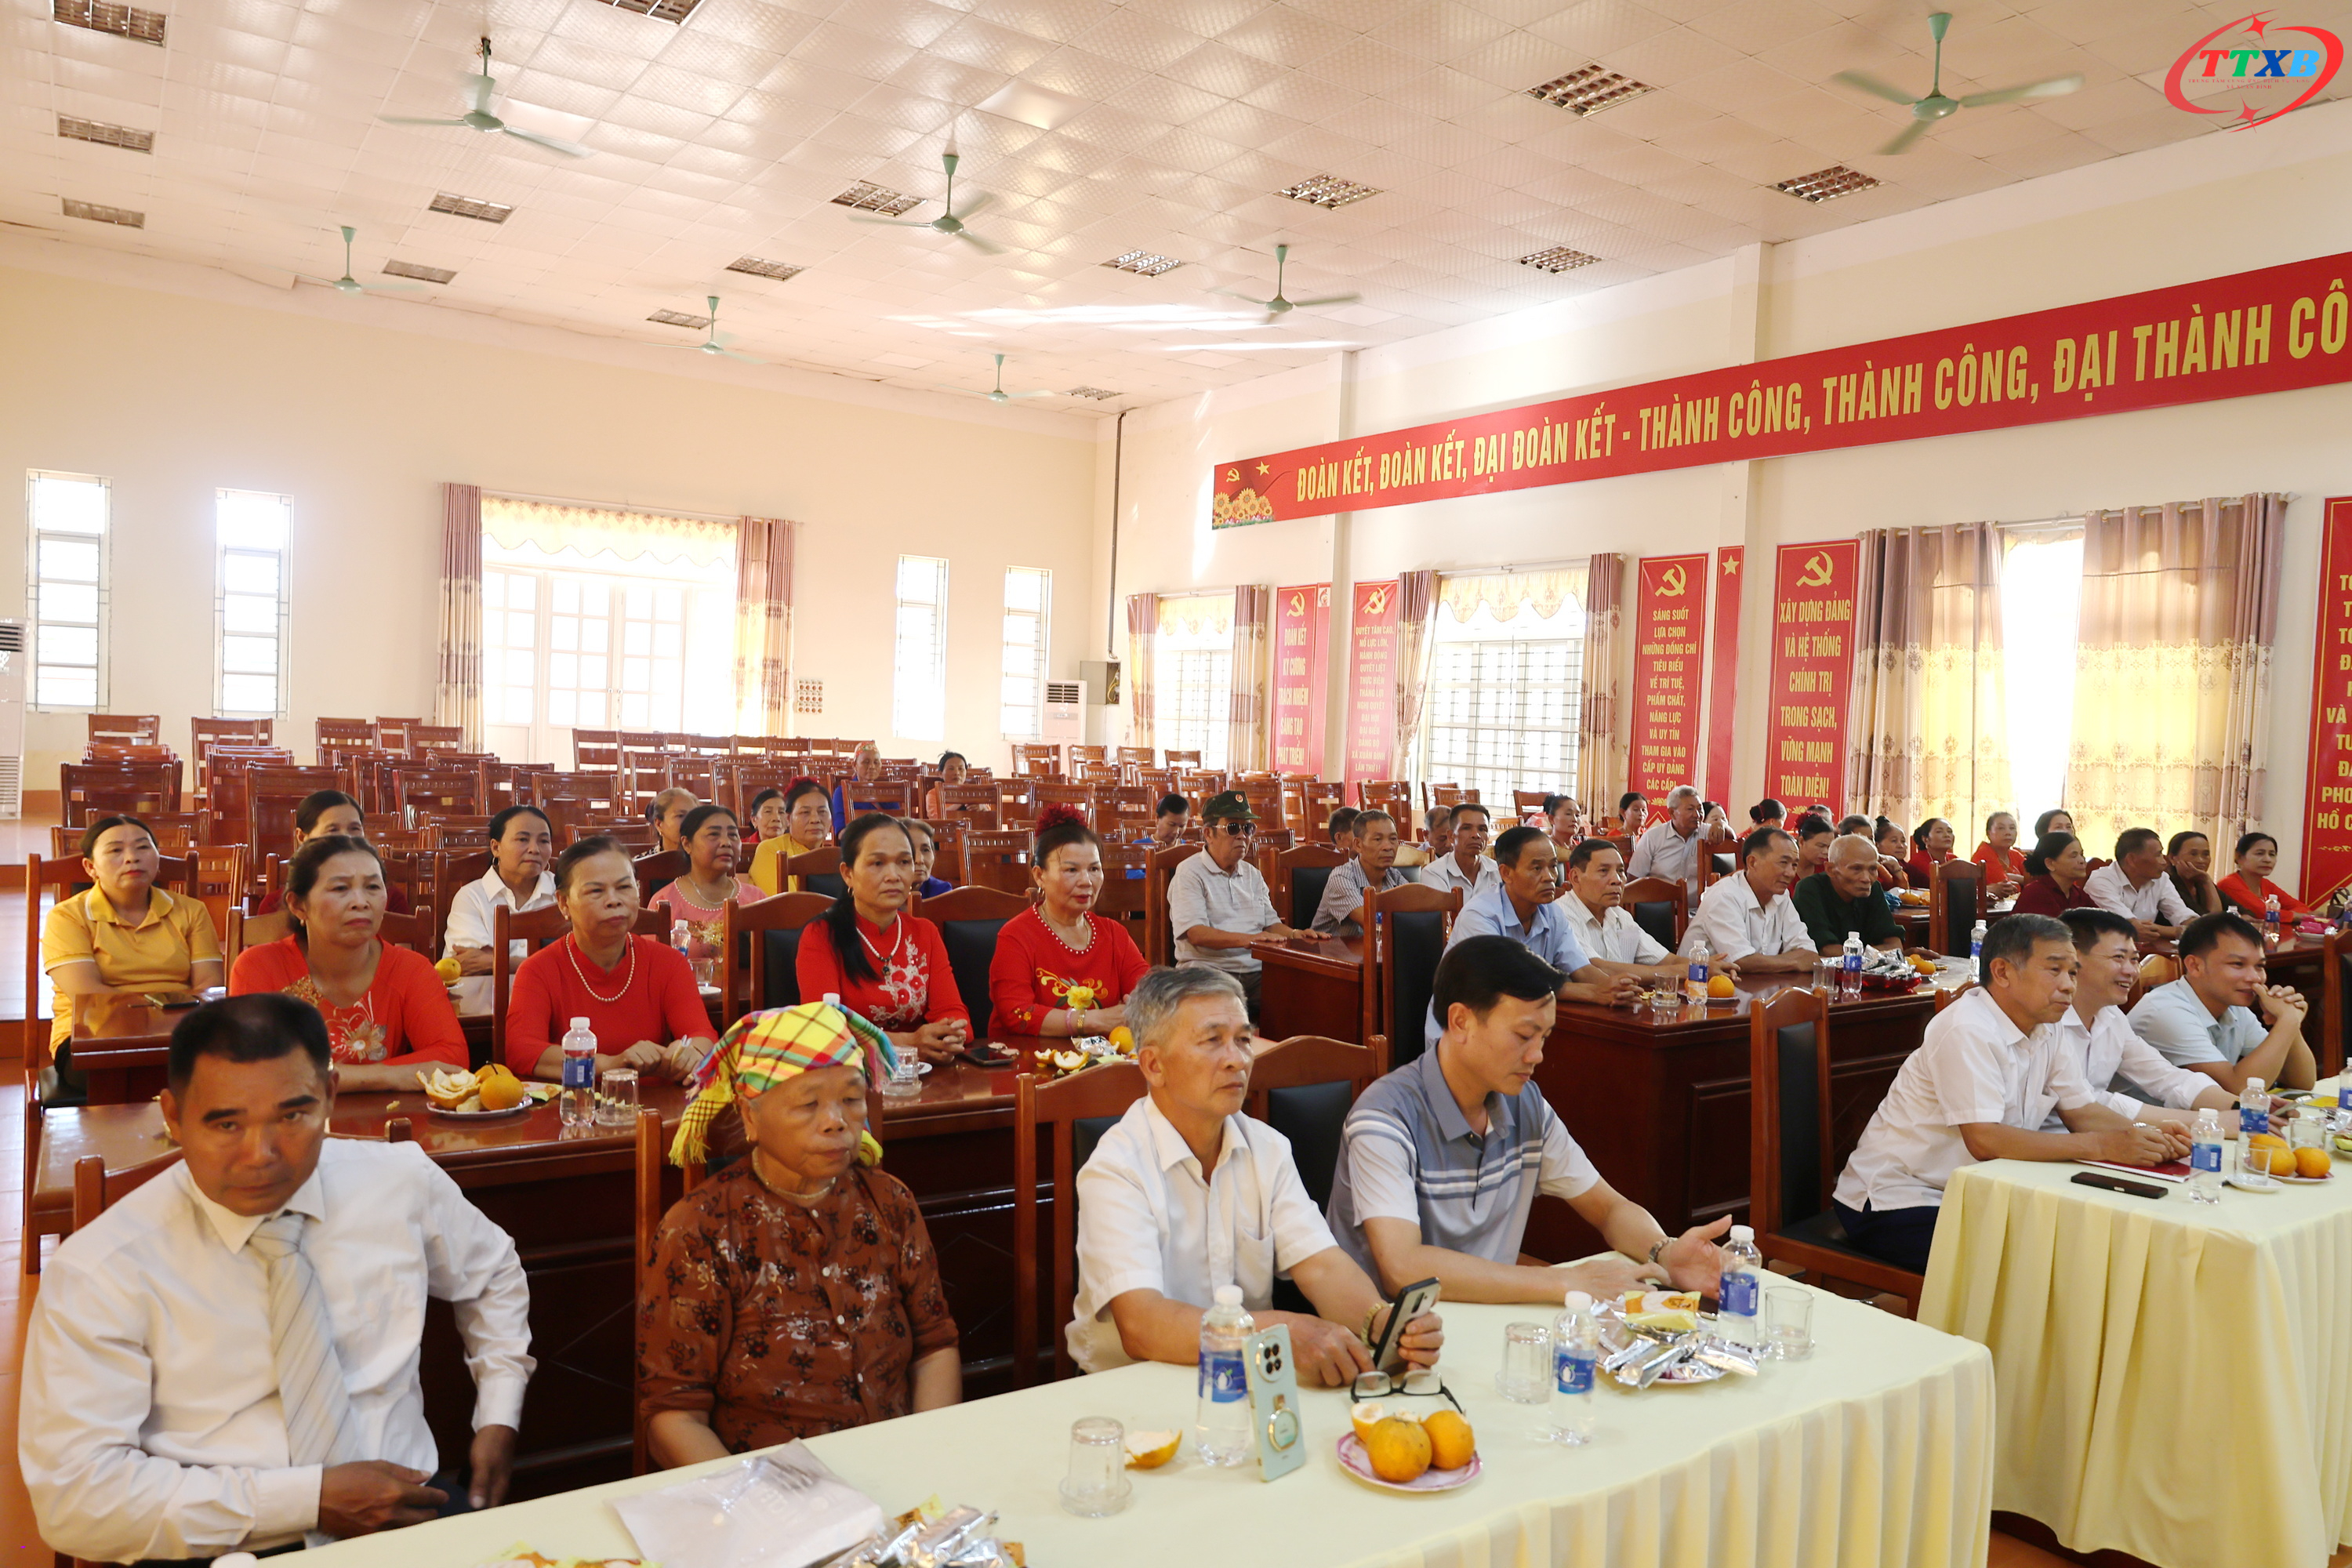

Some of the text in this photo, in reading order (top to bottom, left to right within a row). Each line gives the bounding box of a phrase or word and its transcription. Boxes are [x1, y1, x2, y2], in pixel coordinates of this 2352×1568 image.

[1297, 457, 1338, 502] ĐOÀN
[1342, 446, 1374, 495] KẾT,
[1379, 441, 1427, 490] ĐOÀN
[1431, 429, 1467, 482] KẾT,
[1473, 433, 1507, 482] ĐẠI
[1512, 417, 1569, 470] ĐOÀN
[1574, 401, 1616, 461] KẾT
[1639, 394, 1719, 451] THÀNH
[1728, 381, 1811, 439] CÔNG,
[1823, 361, 1923, 425] THÀNH
[1934, 343, 2038, 411] CÔNG,
[2053, 330, 2118, 401] ĐẠI
[2132, 303, 2272, 382] THÀNH
[2288, 278, 2349, 359] CÔ
[1653, 605, 1689, 621] SÁNG SUỐT
[1779, 590, 1851, 627] XÂY DỰNG ĐẢNG
[1284, 620, 1307, 646] ĐOÀN KẾT
[1356, 624, 1370, 636] QUYẾT
[1371, 625, 1381, 634] TÂM
[1653, 626, 1686, 640] LỰA CHỌN
[1367, 637, 1377, 649] LỰC
[1642, 641, 1664, 655] NHỮNG
[1685, 641, 1697, 655] CHÍ
[1785, 627, 1842, 662] VÀ HỆ THỐNG
[1359, 650, 1388, 662] HÀNH ĐỘNG
[1653, 656, 1683, 672] TIÊU BIỂU
[2339, 654, 2352, 670] Đ
[1359, 662, 1386, 674] QUYẾT LIỆT
[1359, 675, 1385, 688] THỰC HIỆN
[1659, 676, 1670, 689] TRÍ
[1671, 676, 1685, 691] TUỆ,
[1789, 666, 1833, 697] CHÍNH TRỊ
[1278, 684, 1308, 710] TRÁCH NHIỆM
[1646, 690, 1686, 707] PHẨM CHẤT,
[1649, 710, 1682, 725] NĂNG LỰC
[1780, 706, 1837, 732] TRONG SẠCH,
[2326, 704, 2347, 724] VÀ
[1280, 713, 1303, 740] SÁNG TẠO
[1649, 726, 1680, 740] VÀ UY TÍN
[1277, 739, 1305, 766] PHÁT TRIỂN!
[1359, 750, 1373, 760] XUÂN
[1641, 744, 1686, 758] THAM GIA VÀO
[1781, 735, 1833, 768] VỮNG MẠNH
[1642, 758, 1685, 775] CẤP UỶ ĐẢNG
[1646, 777, 1660, 791] CÁC
[1780, 771, 1830, 803] TOÀN DIỆN!
[2317, 808, 2339, 829] HỒ
